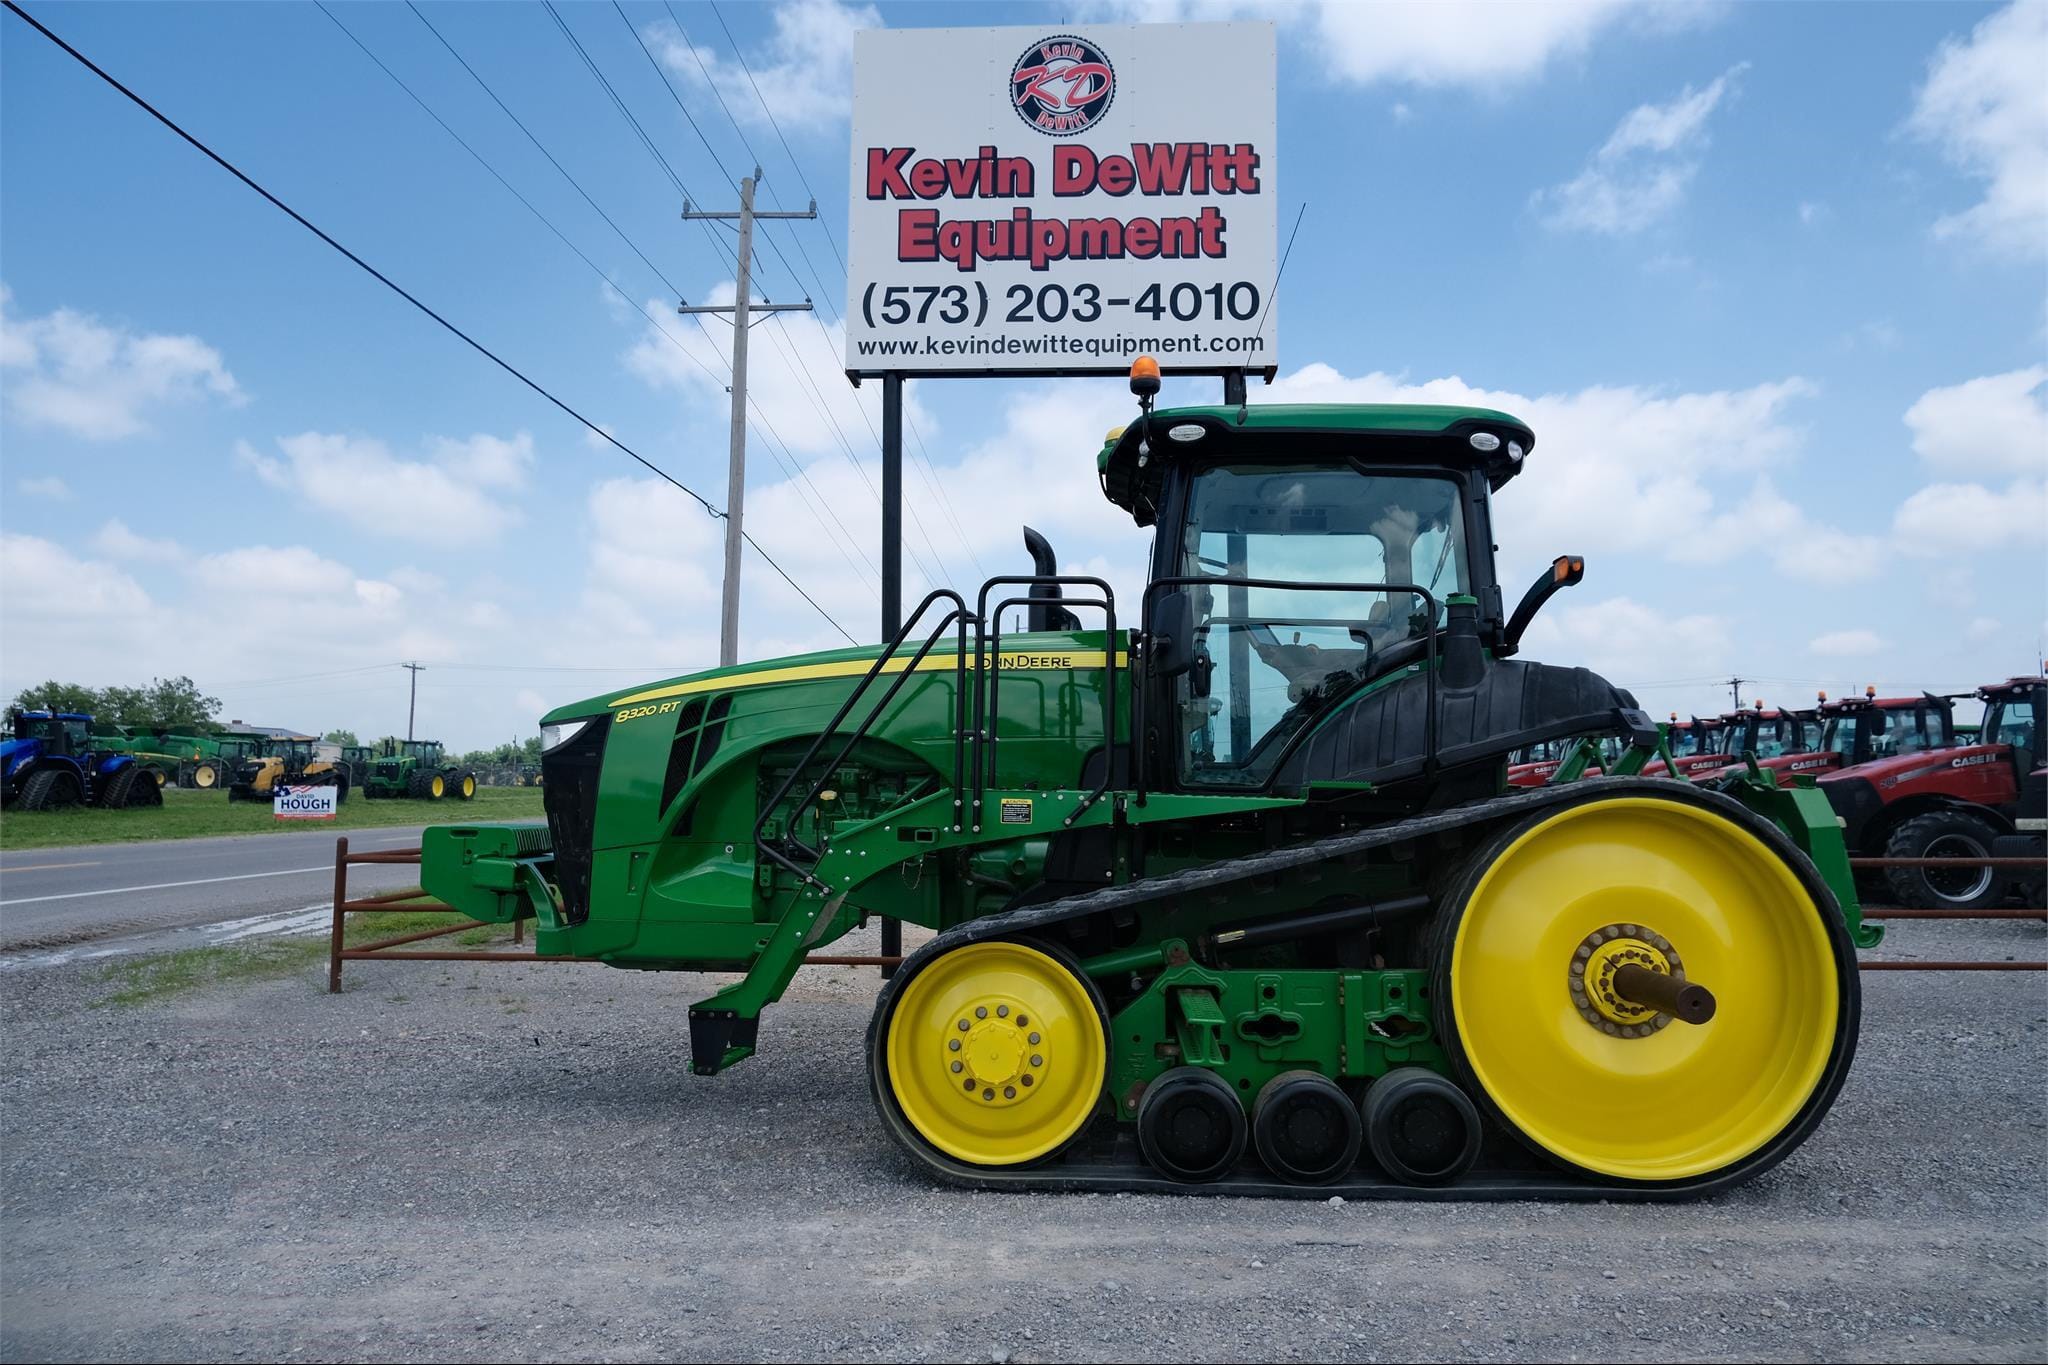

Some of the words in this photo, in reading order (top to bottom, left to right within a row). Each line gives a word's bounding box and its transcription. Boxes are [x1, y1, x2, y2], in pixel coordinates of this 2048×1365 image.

[1041, 43, 1084, 60] Kevin
[1036, 111, 1089, 130] DeWitt
[867, 146, 1034, 200] Kevin
[1052, 142, 1260, 195] DeWitt
[898, 206, 1227, 271] Equipment
[863, 281, 989, 328] (573)
[1005, 280, 1261, 323] 203-4010
[858, 333, 1265, 357] www.kevindewittequipment.com
[615, 705, 657, 723] 8320
[658, 700, 681, 714] RT
[1691, 761, 1714, 770] CASE
[1791, 760, 1818, 770] CASE
[1952, 755, 1984, 768] CASE
[281, 799, 330, 810] HOUGH
